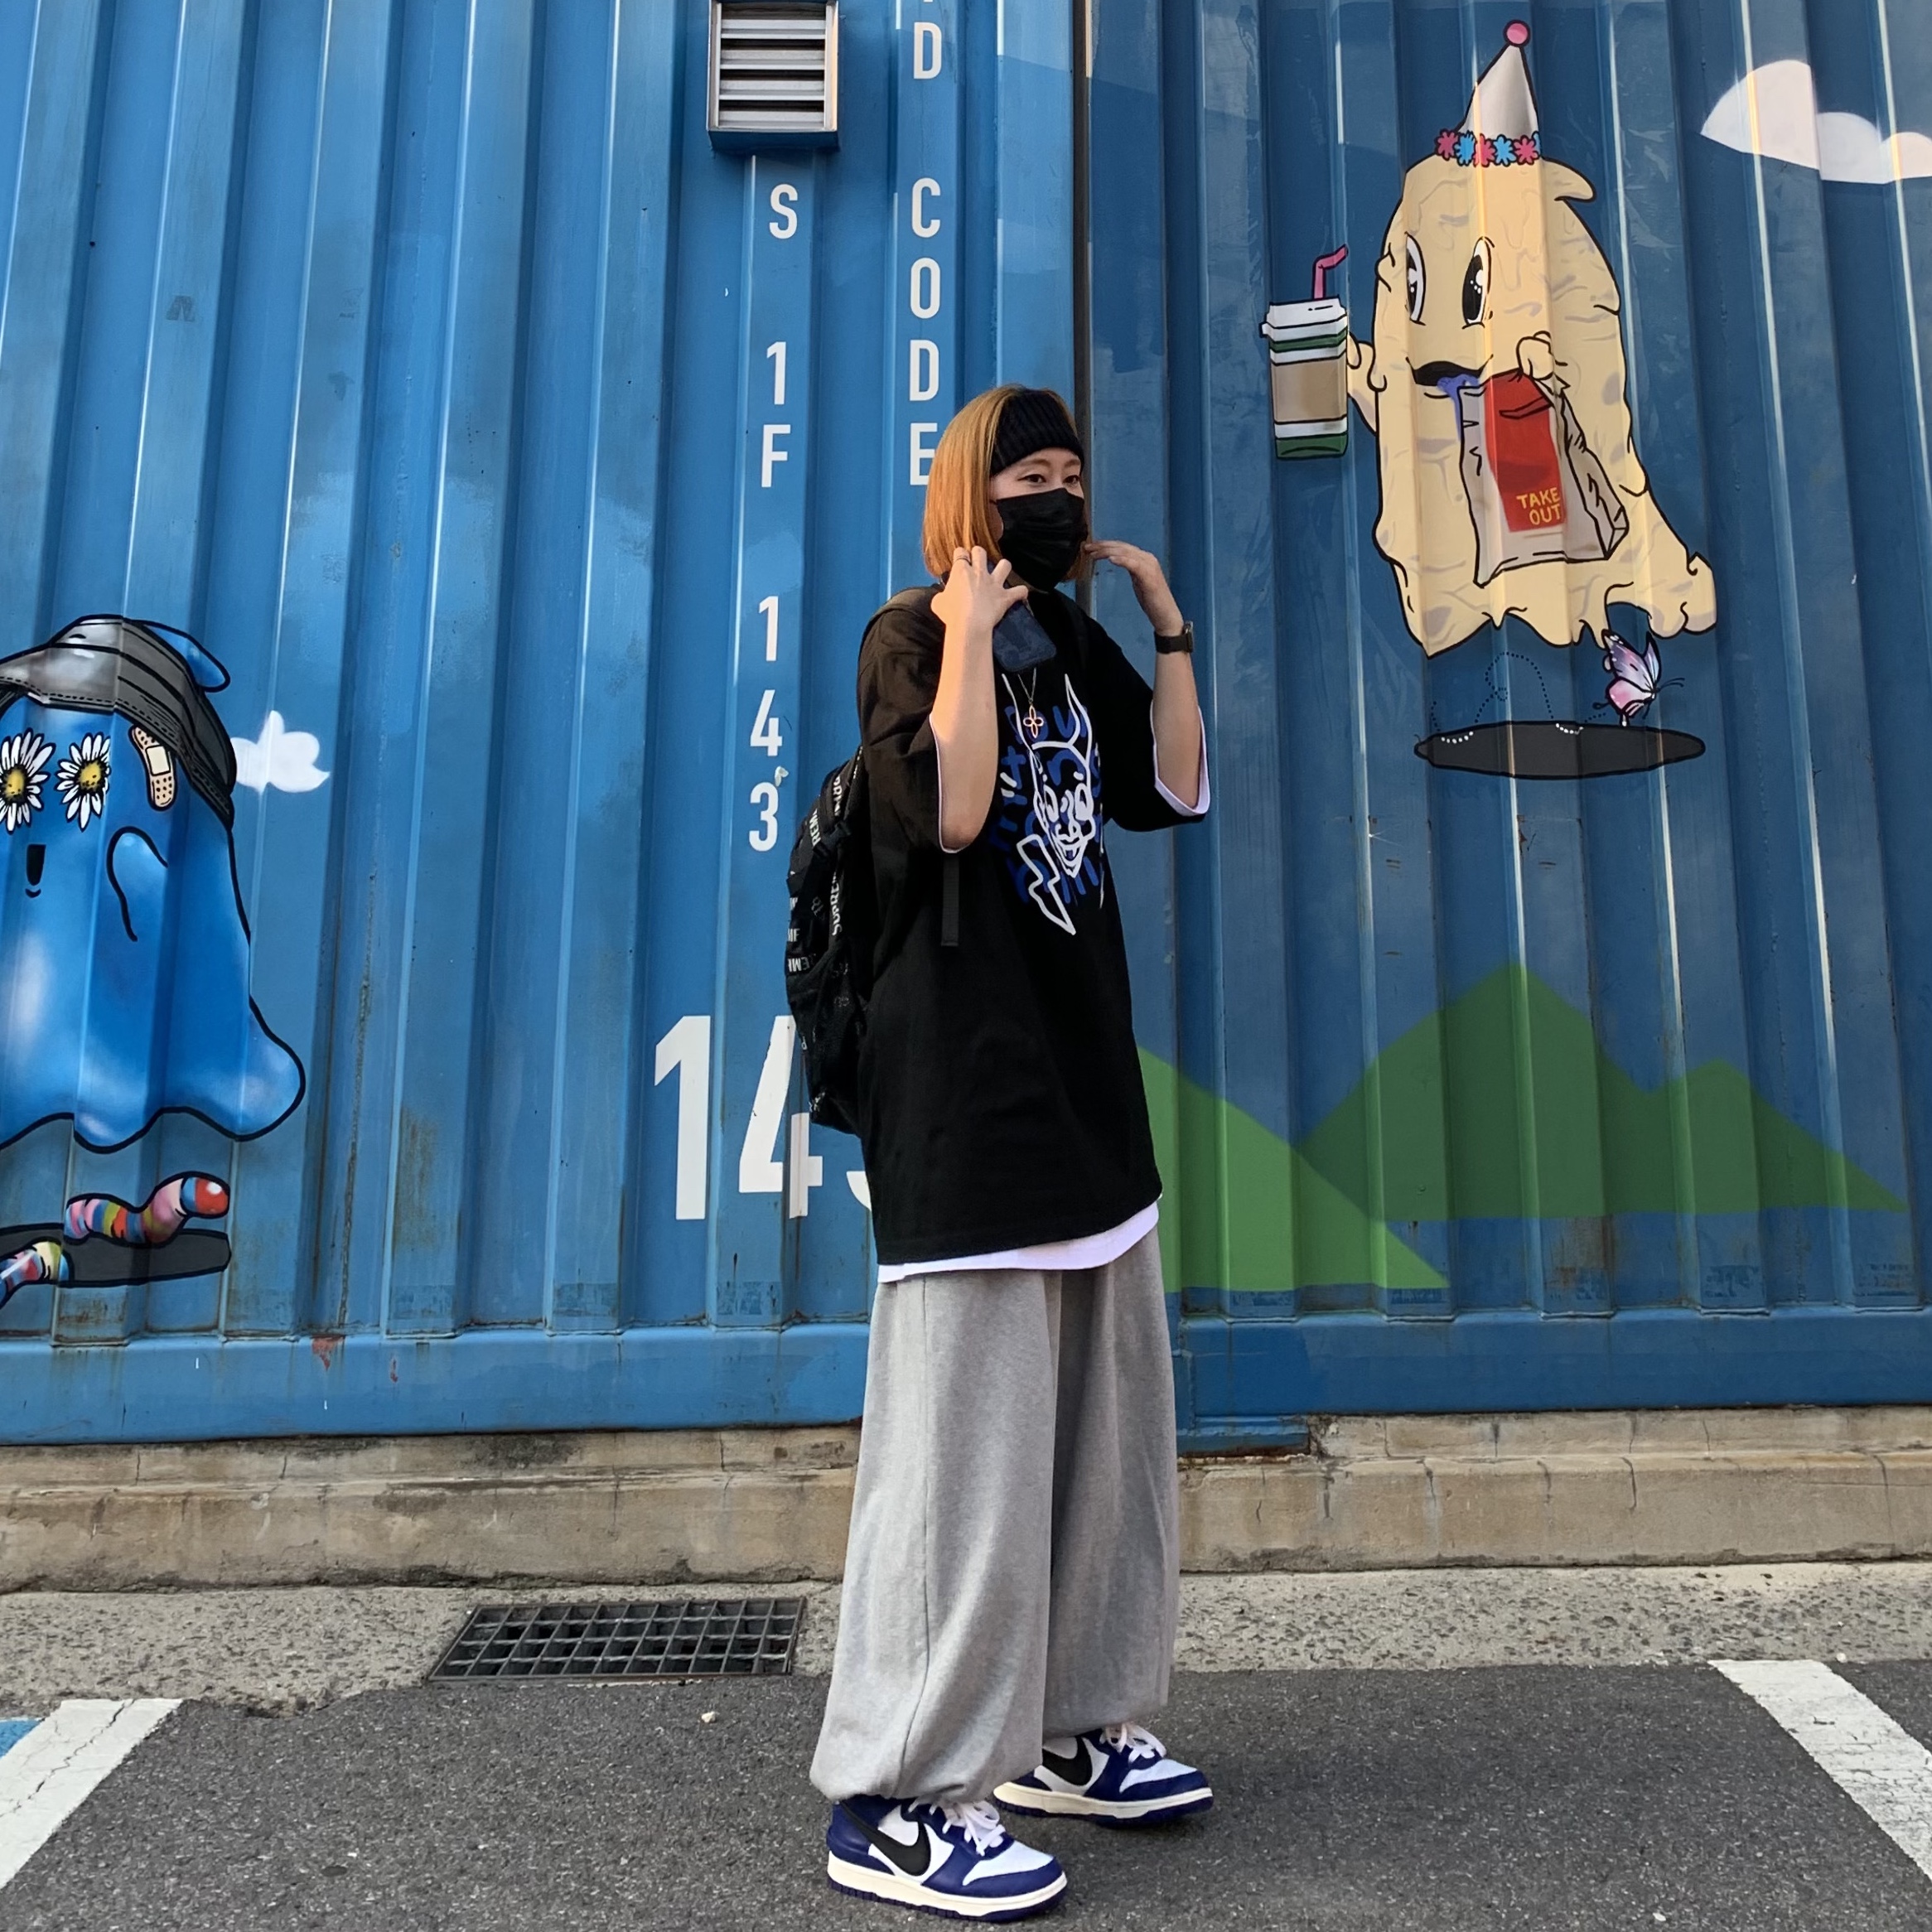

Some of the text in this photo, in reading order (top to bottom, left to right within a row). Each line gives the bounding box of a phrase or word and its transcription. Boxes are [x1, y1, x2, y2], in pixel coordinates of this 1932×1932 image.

[910, 0, 943, 485] D CODE
[761, 341, 791, 487] 1F
[1516, 486, 1561, 510] TAKE
[1529, 505, 1561, 525] OUT
[748, 595, 783, 852] 143
[654, 1015, 872, 1220] 14
